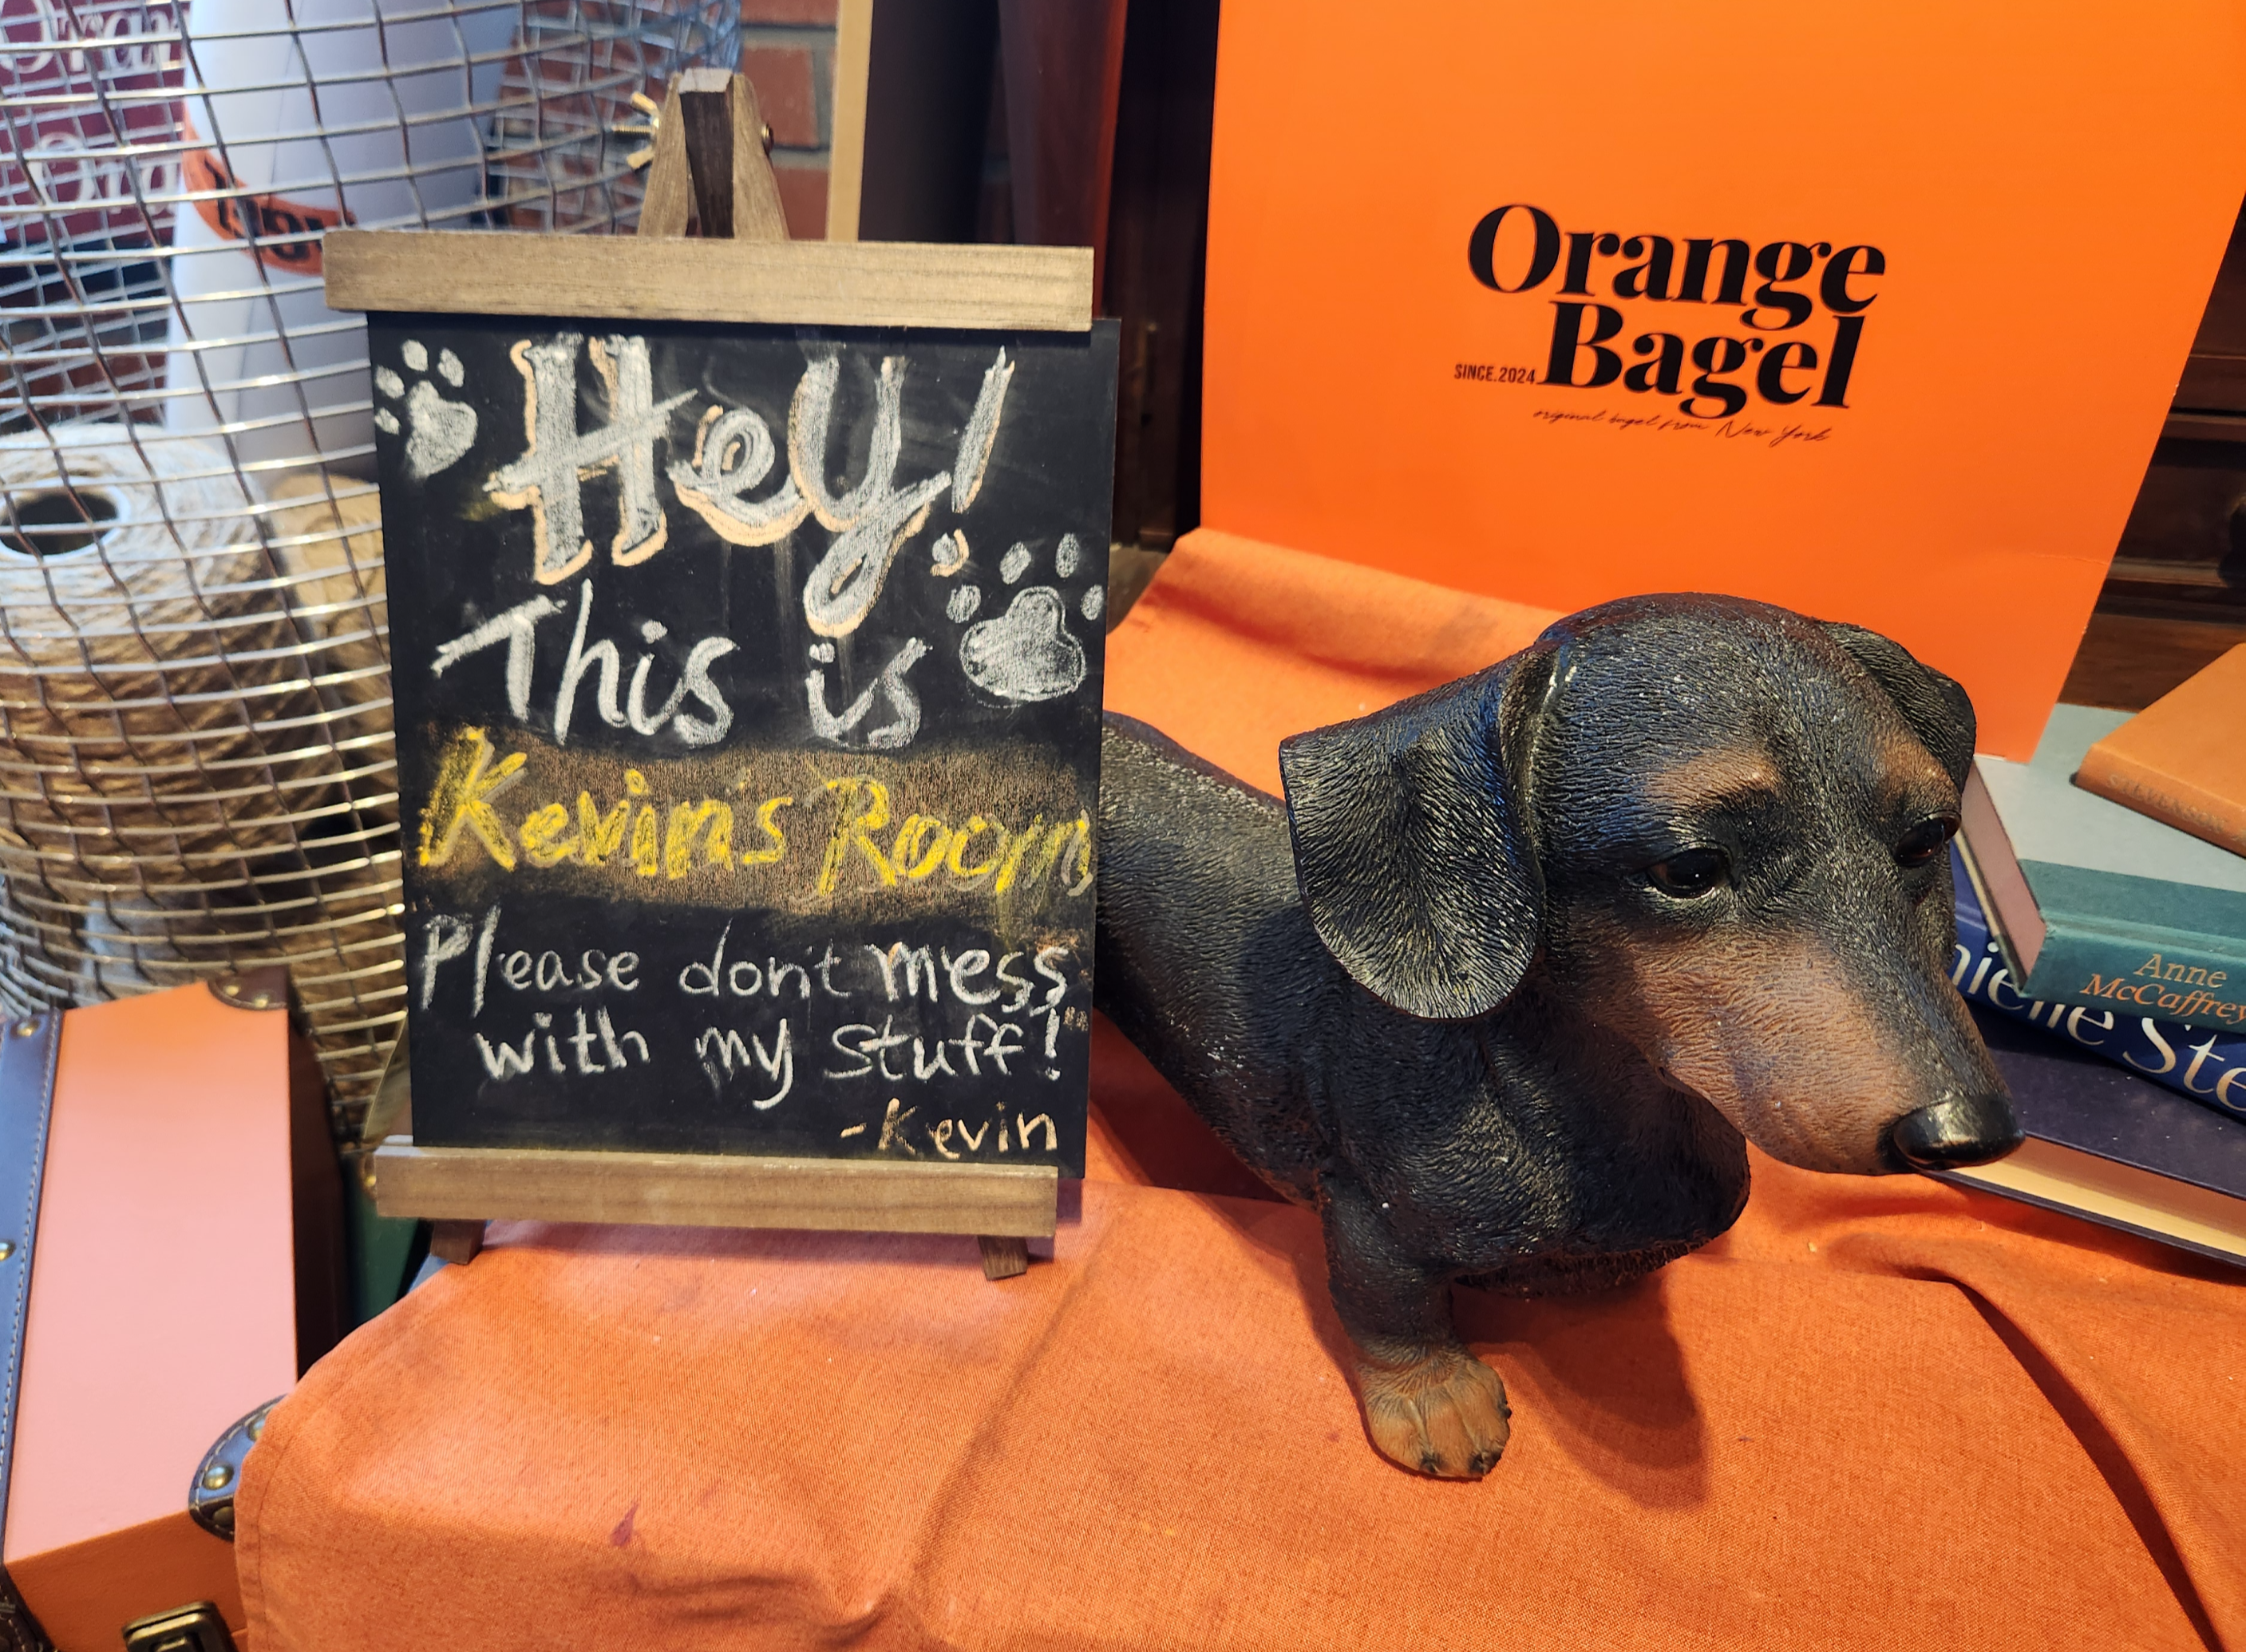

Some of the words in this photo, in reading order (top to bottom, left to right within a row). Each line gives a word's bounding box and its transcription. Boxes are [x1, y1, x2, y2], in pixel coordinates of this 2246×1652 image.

[1467, 203, 1886, 331] Orange
[1453, 364, 1536, 385] SINCE.2024
[1536, 300, 1866, 419] Bagel
[1532, 409, 1607, 425] original
[1608, 413, 1661, 431] bagel
[1657, 417, 1710, 431] from
[1714, 418, 1771, 438] New
[1767, 423, 1833, 448] York
[431, 579, 742, 747] This
[804, 635, 934, 751] is
[808, 770, 1096, 899] Room
[420, 903, 639, 1019] Please
[864, 940, 1070, 1018] mess
[2078, 973, 2246, 1026] McCaffrey
[2133, 953, 2228, 989] Anne
[475, 1006, 651, 1082] with
[694, 1018, 795, 1112] my
